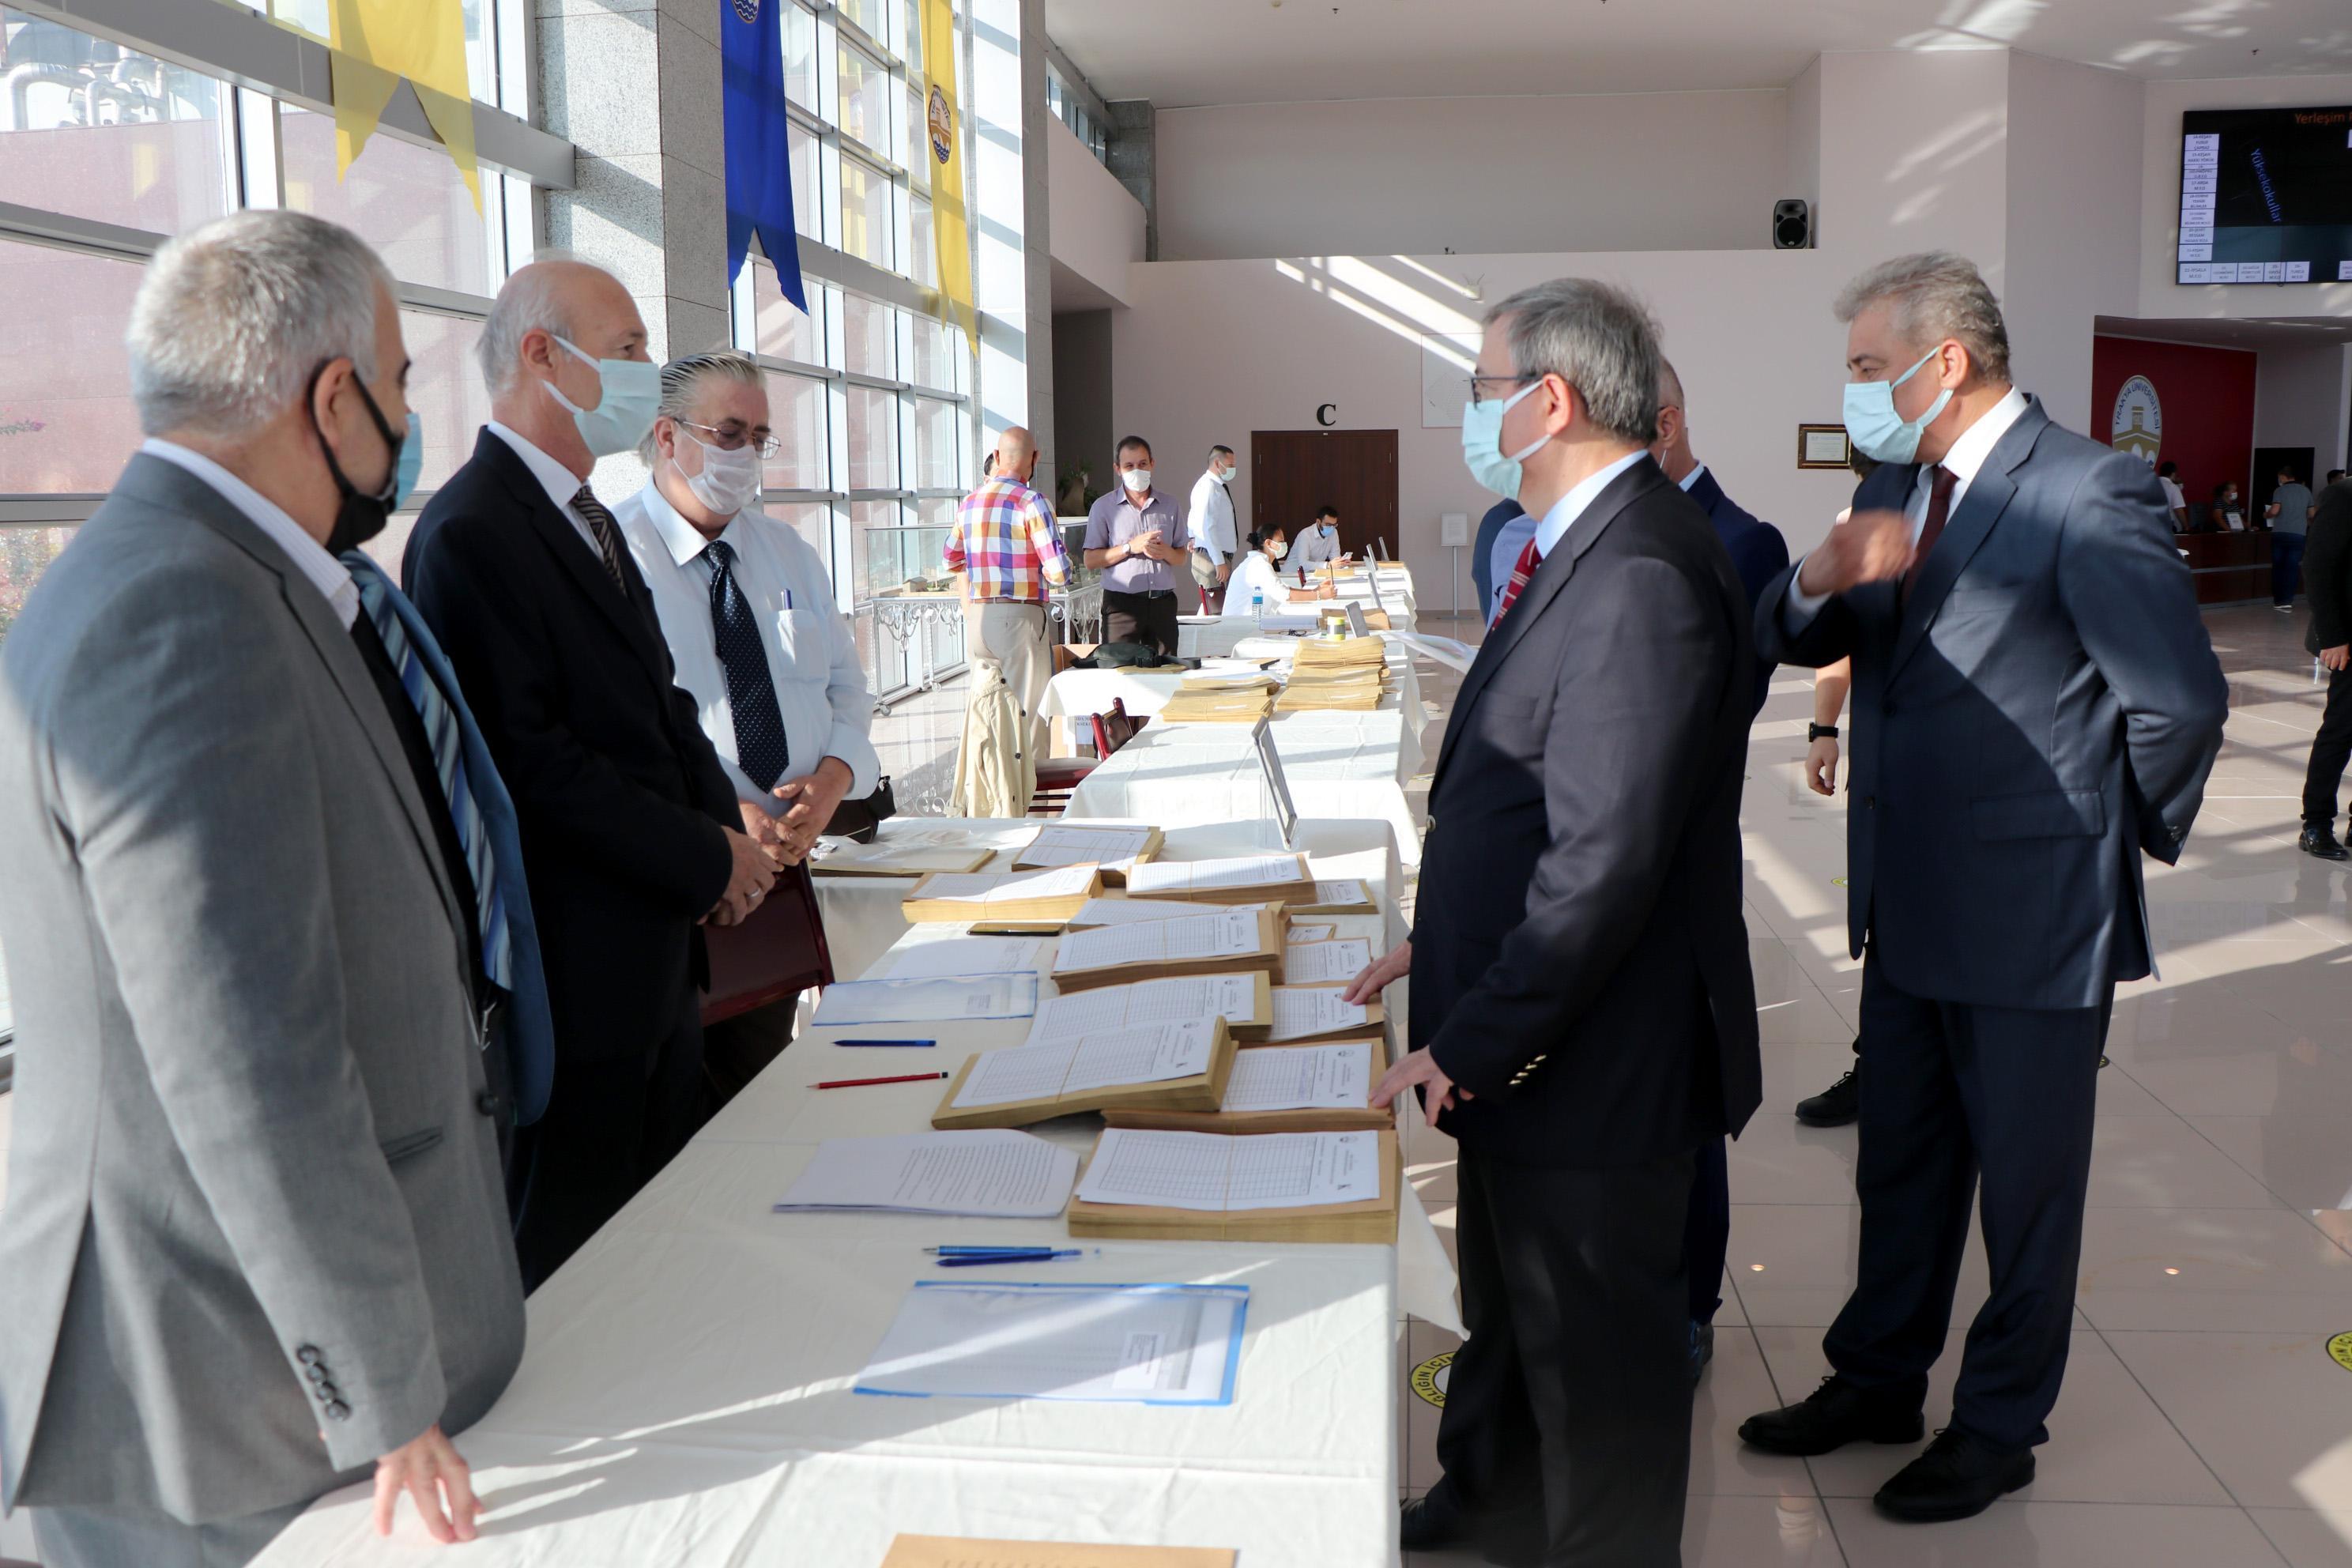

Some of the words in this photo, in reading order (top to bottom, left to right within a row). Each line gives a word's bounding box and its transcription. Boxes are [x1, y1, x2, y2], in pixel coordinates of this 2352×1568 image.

[2295, 112, 2346, 125] Yerleşim
[2251, 148, 2282, 222] Yüksekokullar
[1317, 404, 1336, 426] C
[2115, 387, 2132, 425] TRAKYA
